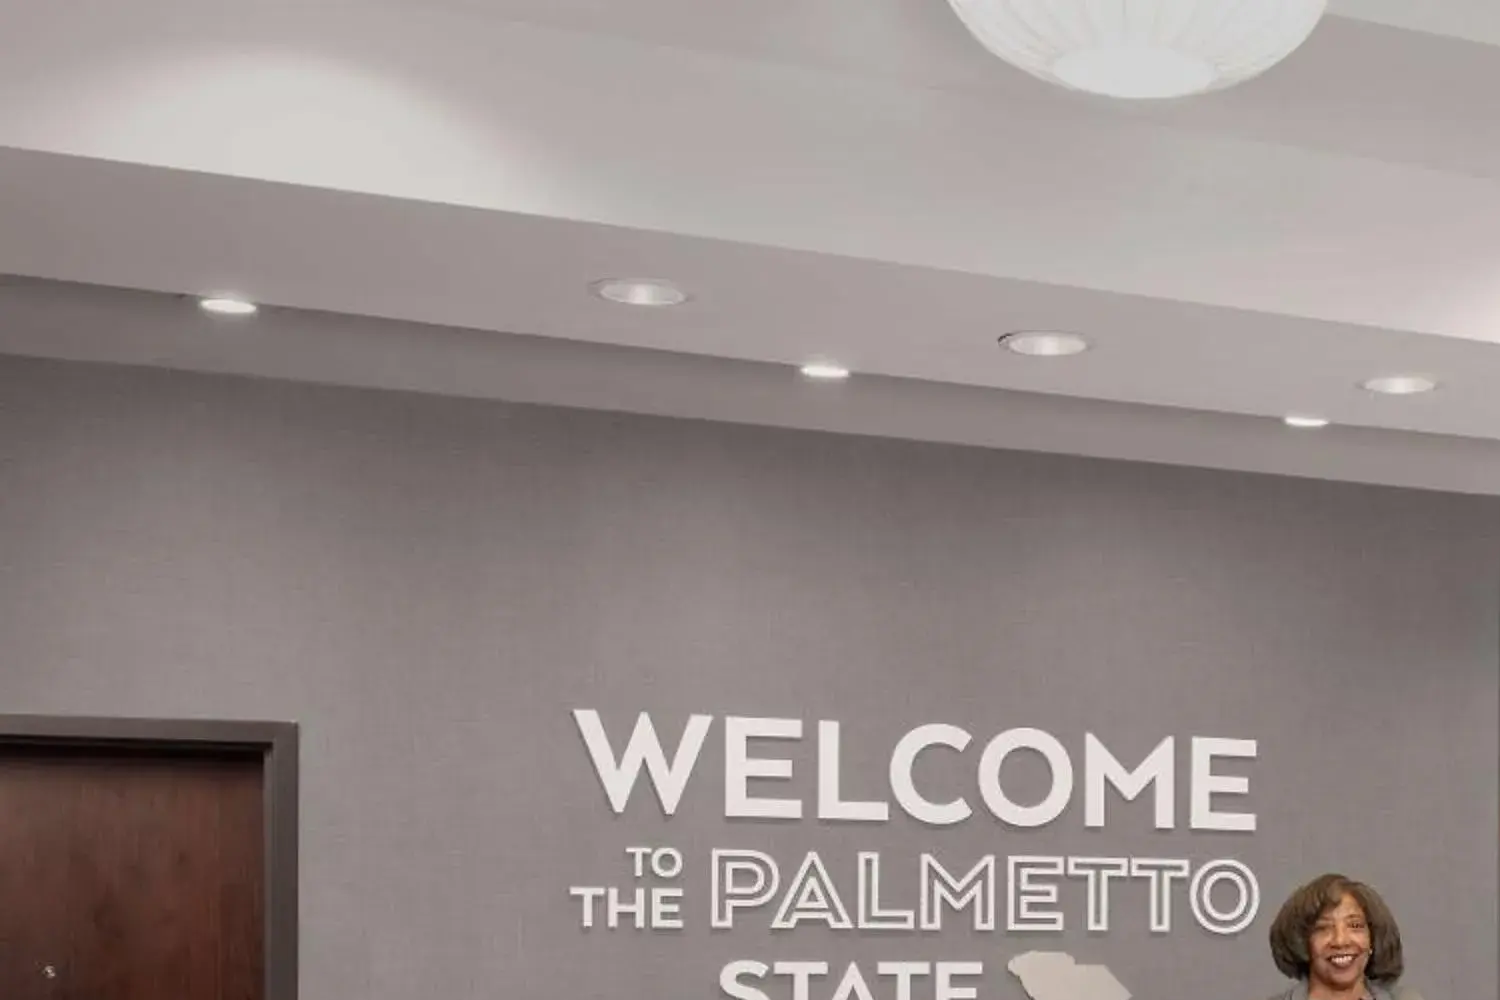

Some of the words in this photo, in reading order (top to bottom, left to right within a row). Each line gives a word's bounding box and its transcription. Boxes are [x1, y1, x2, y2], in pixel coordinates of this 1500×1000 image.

[573, 709, 1257, 831] WELCOME
[569, 886, 684, 929] THE
[711, 847, 1260, 934] PALMETTO
[625, 847, 684, 878] TO
